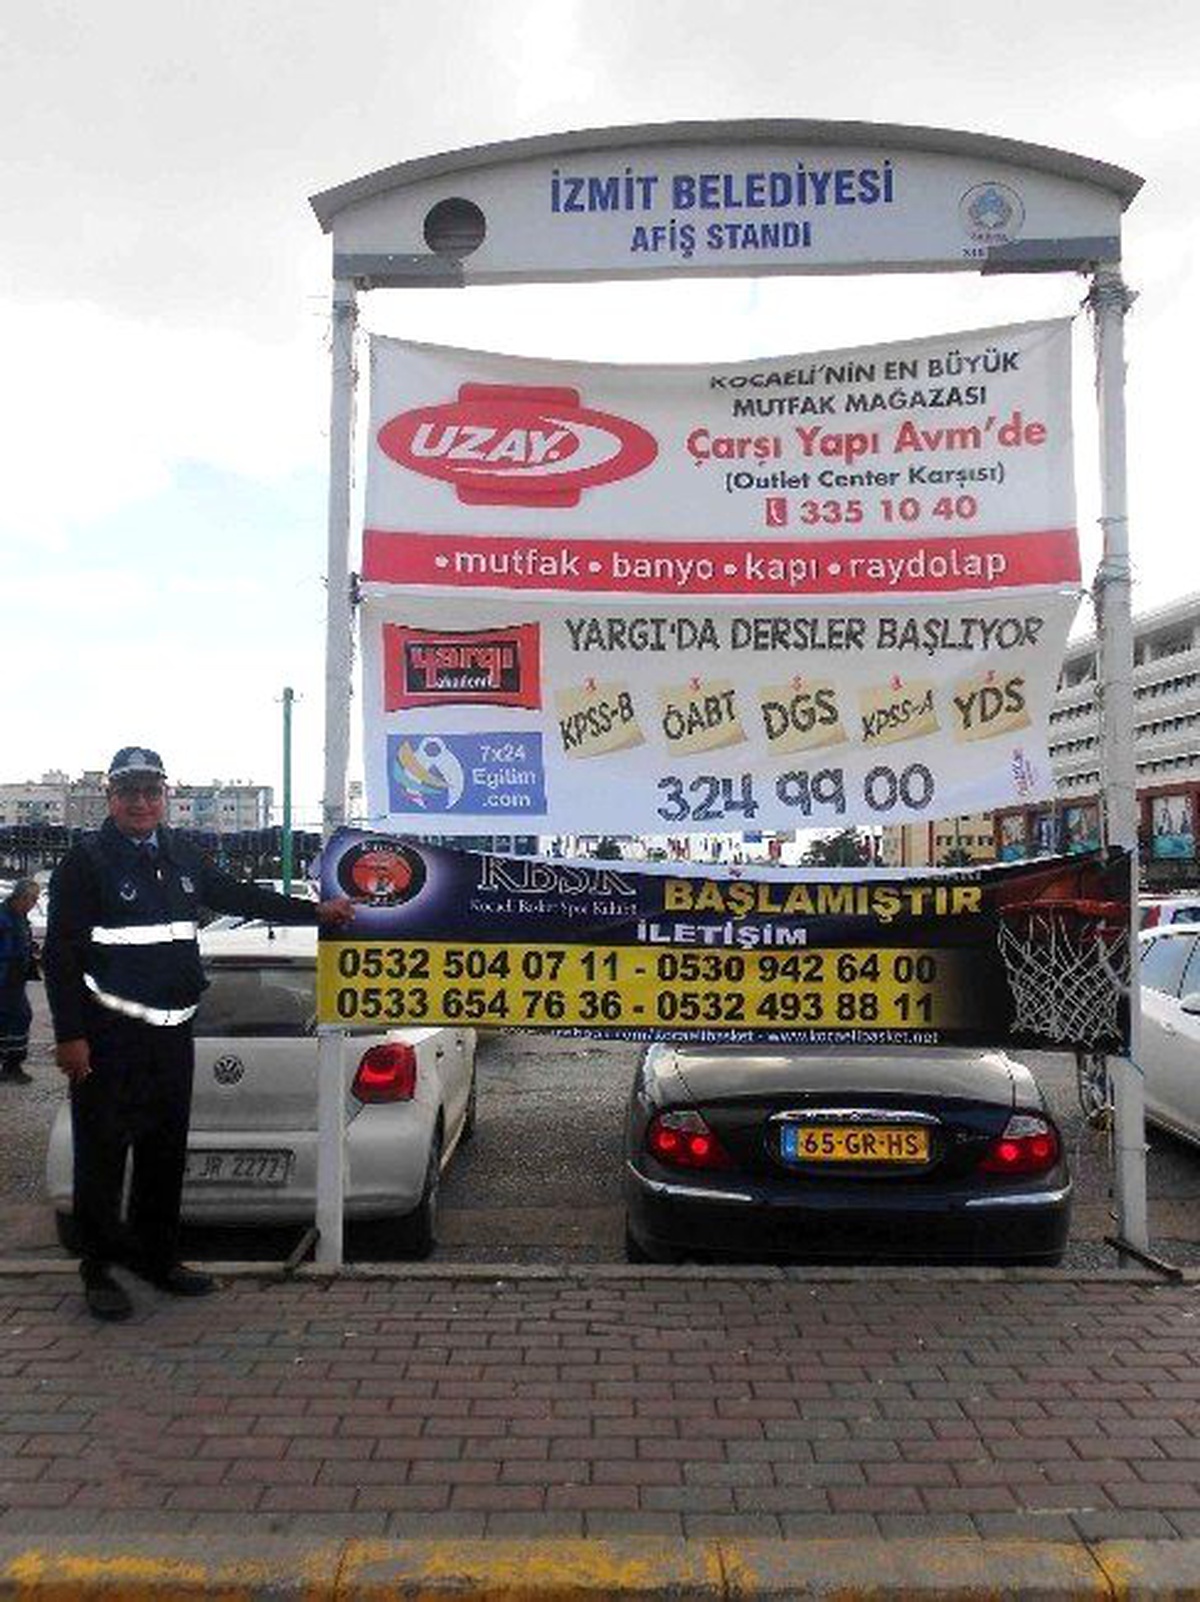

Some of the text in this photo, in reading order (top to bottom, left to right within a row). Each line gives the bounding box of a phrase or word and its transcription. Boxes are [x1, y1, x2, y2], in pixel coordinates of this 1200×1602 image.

[551, 160, 893, 212] İZMİT BELEDİYESİ
[630, 219, 811, 257] AFİŞ STANDI
[710, 349, 1019, 389] KOCAELİ'NİN EN BÜYÜK
[733, 386, 986, 417] MUTFAK MAĞAZASI
[686, 410, 1048, 467] Çarşı Yapı Avm'de
[726, 462, 1005, 493] (Outlet Center Karşısı)
[800, 495, 977, 524] 335 10 40
[455, 548, 1007, 587] mutfak banyo kapı raydolap
[565, 616, 1044, 655] YARGI'DA DERSLER BAŞLIYOR
[559, 692, 634, 751] KPSS-B
[662, 689, 736, 740] ÖABT
[761, 689, 838, 740] DGS
[953, 677, 1025, 729] YDS
[480, 743, 525, 763] 7x24
[482, 793, 530, 807] .com
[657, 763, 935, 822] 324 99 00
[664, 880, 983, 922] BAŞLAMIŞTIR
[637, 920, 807, 949] İLETİŞİM
[339, 949, 430, 980] 0532
[443, 950, 510, 979] 504
[522, 951, 565, 980] 07
[580, 951, 617, 981] 11
[657, 954, 745, 982] 0530
[758, 954, 824, 983] 942
[837, 954, 880, 983] 64
[894, 955, 936, 983] 00
[337, 988, 429, 1018] 0533
[443, 989, 509, 1018] 654
[522, 990, 565, 1019] 76
[579, 990, 621, 1020] 36
[657, 992, 745, 1021] 0532
[757, 993, 823, 1021] 493
[837, 993, 878, 1021] 88
[894, 992, 933, 1022] 11
[804, 1132, 920, 1156] 65-GR-HS
